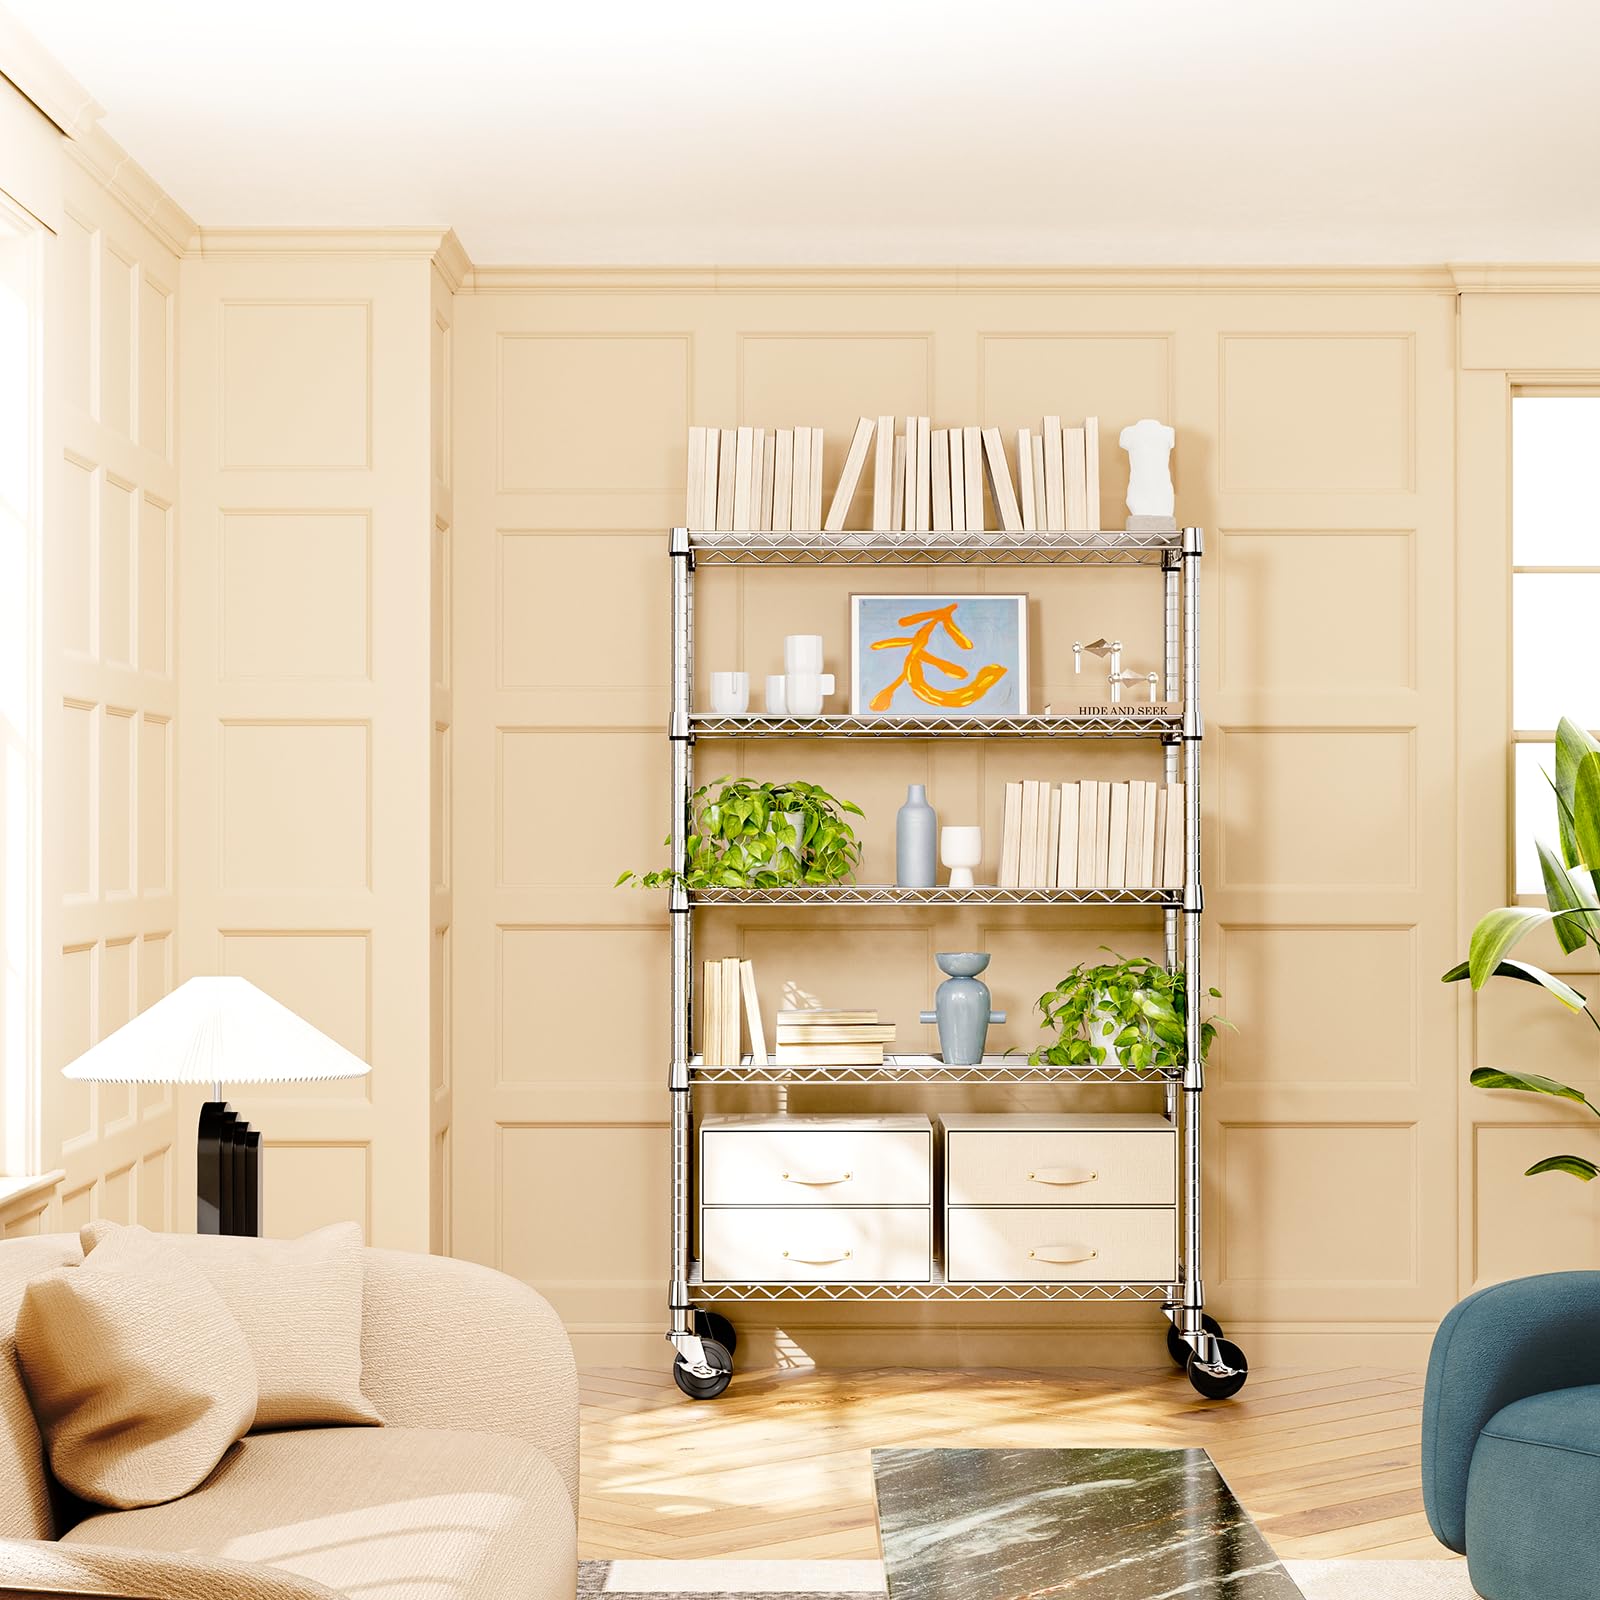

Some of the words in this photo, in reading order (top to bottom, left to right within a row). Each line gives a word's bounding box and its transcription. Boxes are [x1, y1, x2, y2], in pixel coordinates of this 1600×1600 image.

[1079, 706, 1108, 715] HIDE
[1110, 706, 1135, 715] AND
[1137, 706, 1168, 715] SEEK
